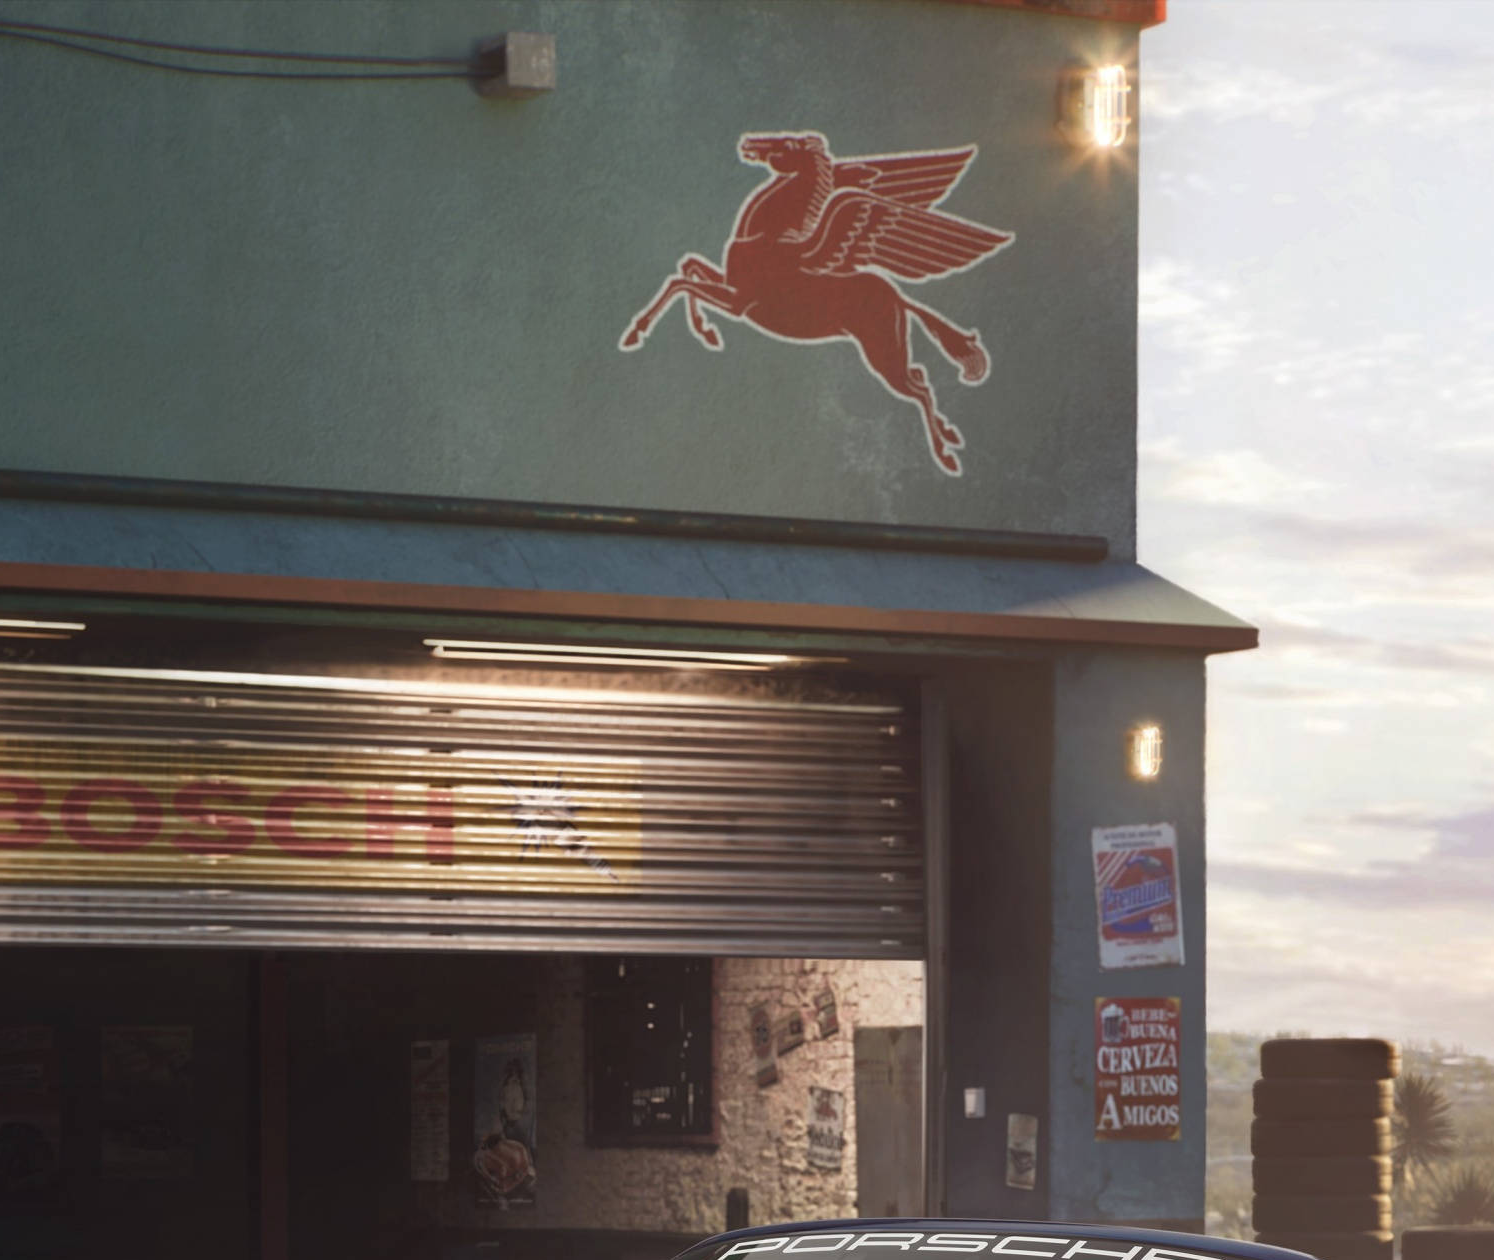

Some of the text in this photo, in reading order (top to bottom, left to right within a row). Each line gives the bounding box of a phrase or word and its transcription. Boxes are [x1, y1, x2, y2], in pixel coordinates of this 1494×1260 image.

[1129, 1023, 1178, 1041] BUENA
[1097, 1043, 1178, 1074] CERVEZA
[1120, 1074, 1178, 1096] BUENOS
[1096, 1093, 1179, 1131] AMIGOS
